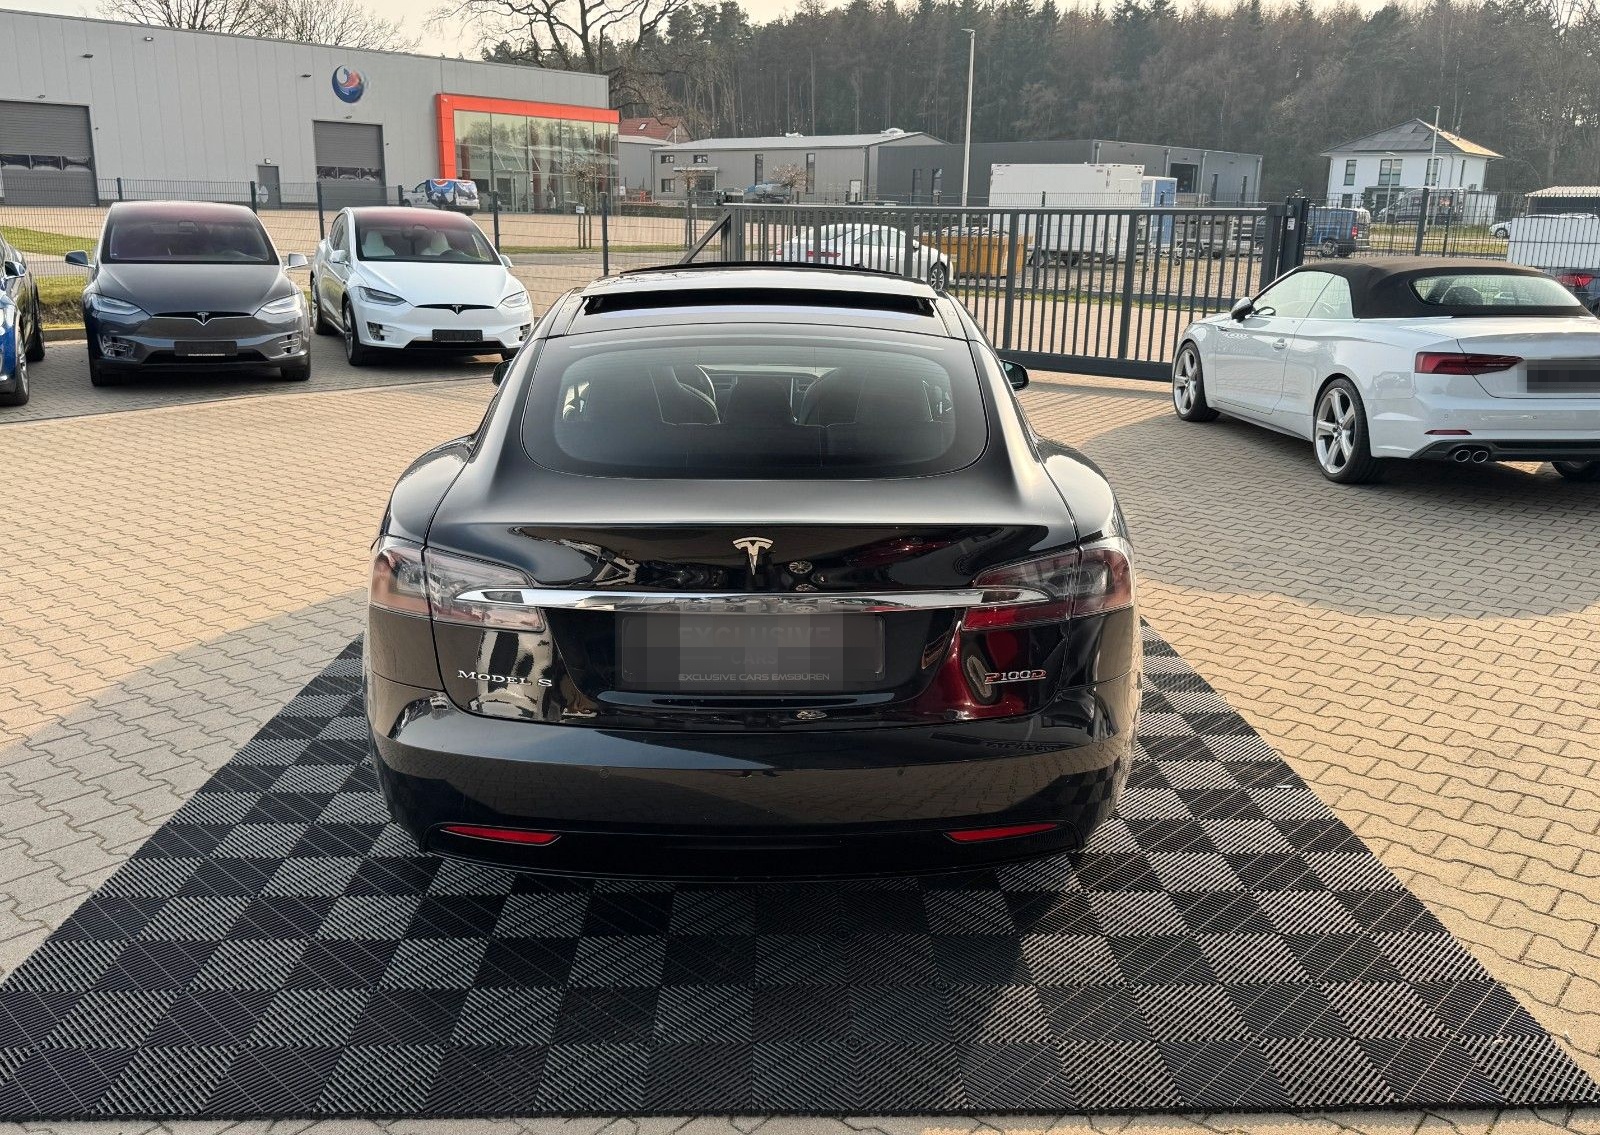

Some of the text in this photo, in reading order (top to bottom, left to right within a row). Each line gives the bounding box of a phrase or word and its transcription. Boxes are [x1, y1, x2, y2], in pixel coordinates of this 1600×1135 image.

[457, 670, 553, 687] MODEL S
[678, 672, 830, 681] EXCLUSIVE CARS EMSBÜREN
[985, 669, 1047, 685] P100D
